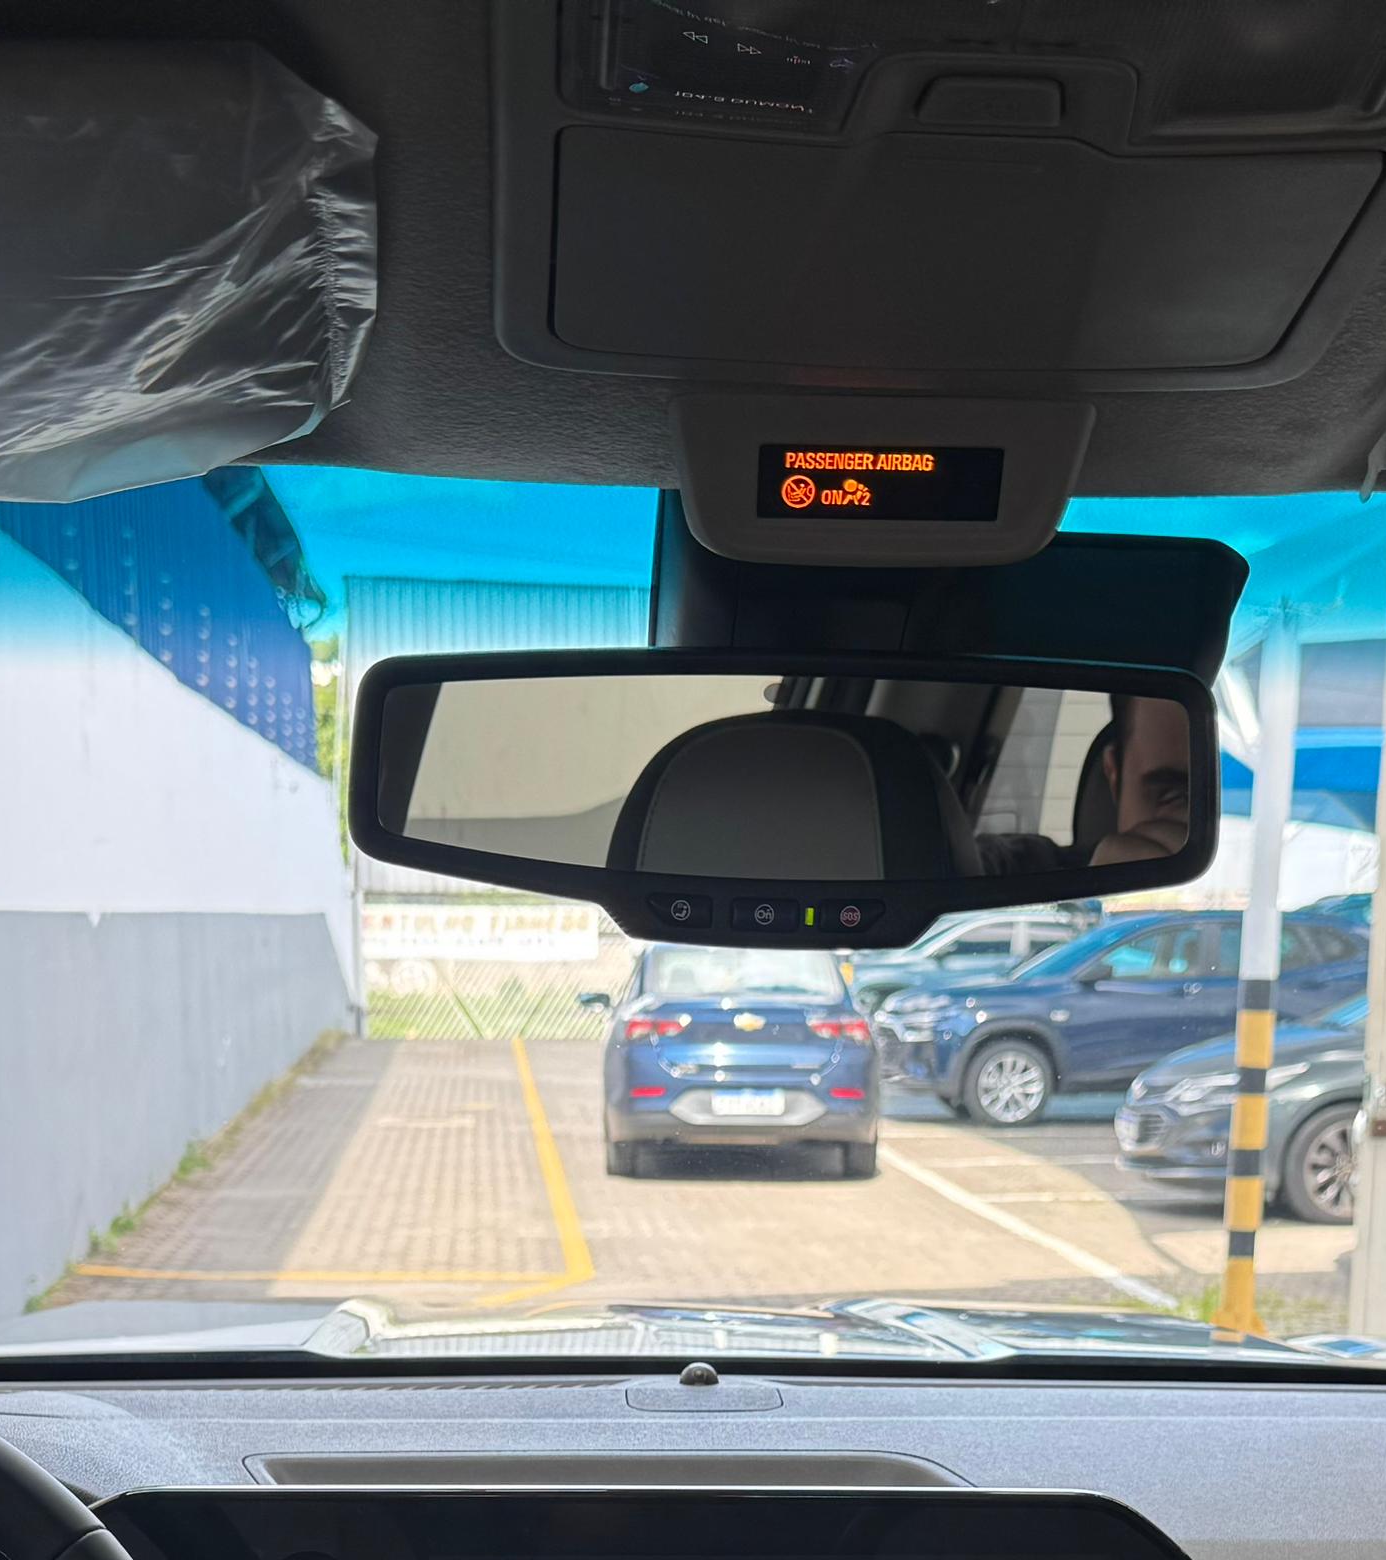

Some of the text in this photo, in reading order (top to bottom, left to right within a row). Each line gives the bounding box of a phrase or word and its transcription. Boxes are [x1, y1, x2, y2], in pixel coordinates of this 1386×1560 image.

[785, 452, 934, 471] PASSENGER AIRBAG
[821, 490, 843, 505] ON
[841, 912, 859, 921] SOS
